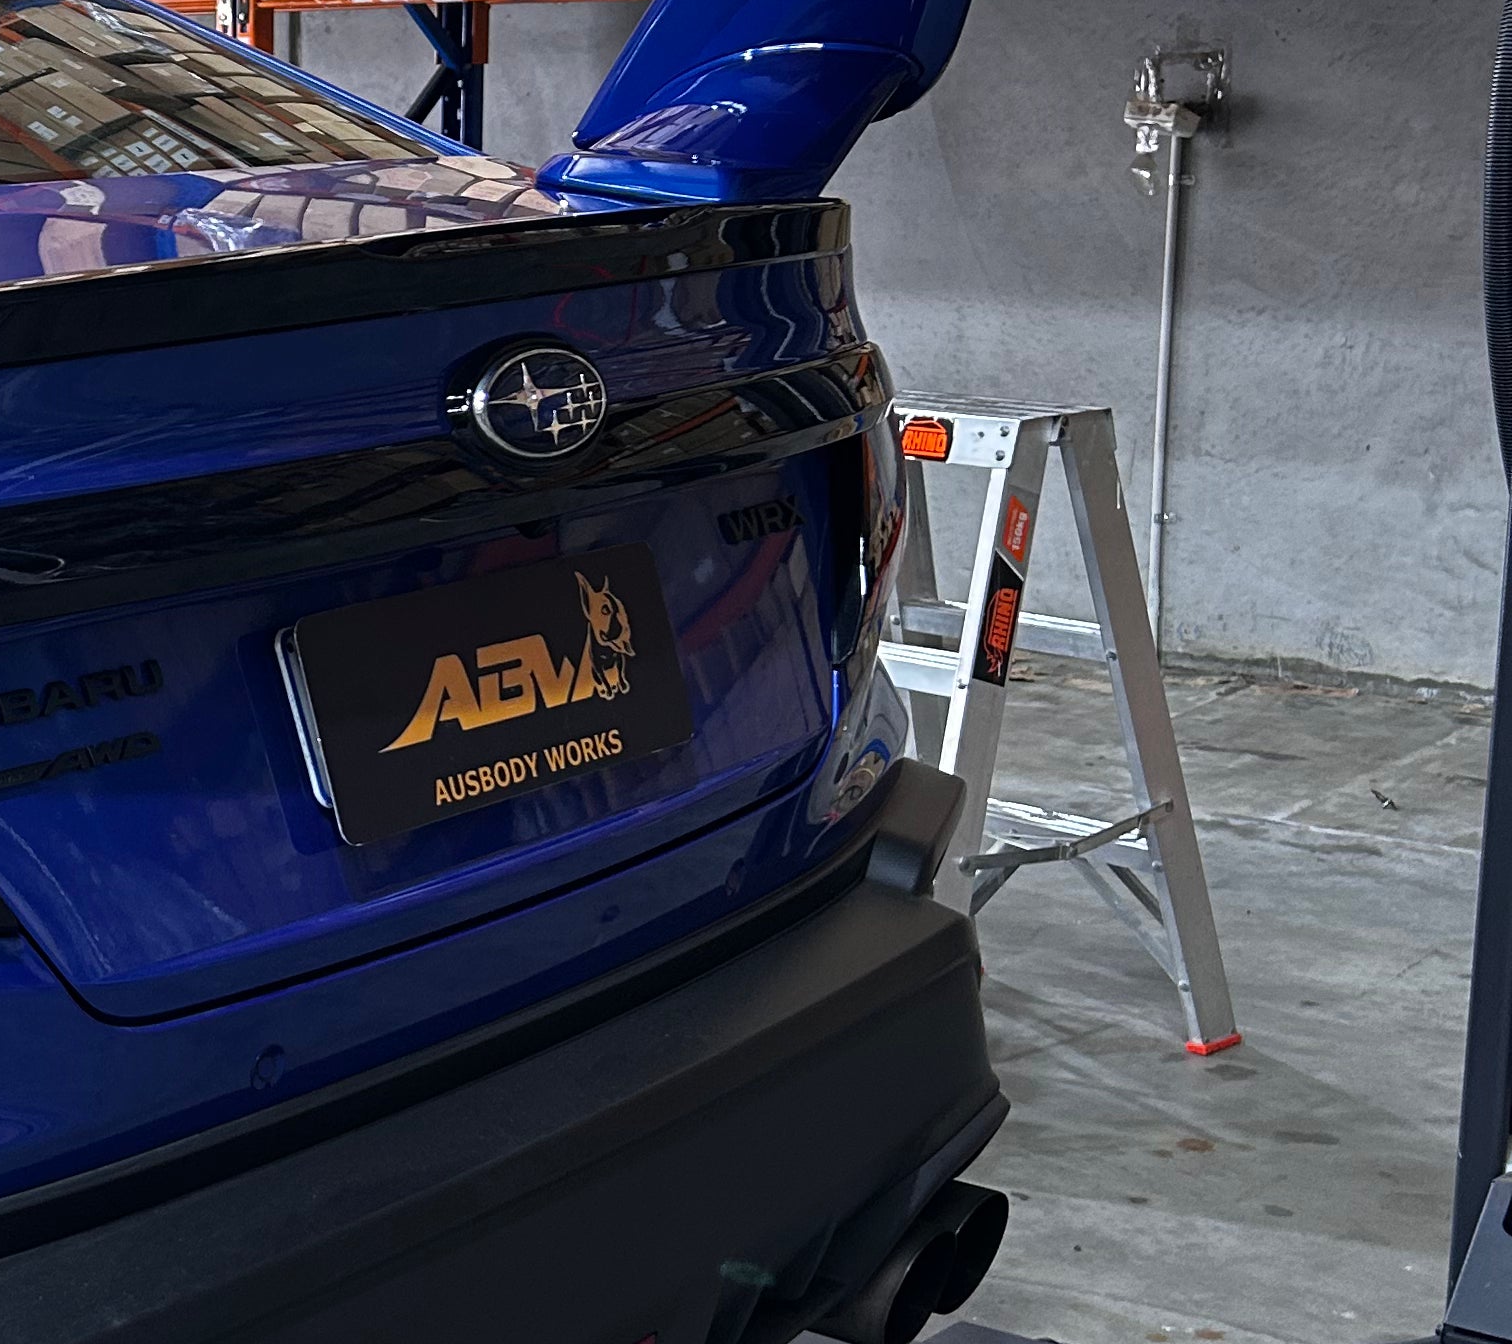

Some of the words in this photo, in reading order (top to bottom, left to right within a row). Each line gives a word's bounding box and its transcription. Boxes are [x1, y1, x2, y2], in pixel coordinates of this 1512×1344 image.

[901, 429, 948, 453] RHINO
[991, 587, 1016, 652] RHINO
[434, 754, 539, 806] AUSBODY
[547, 728, 624, 773] WORKS
